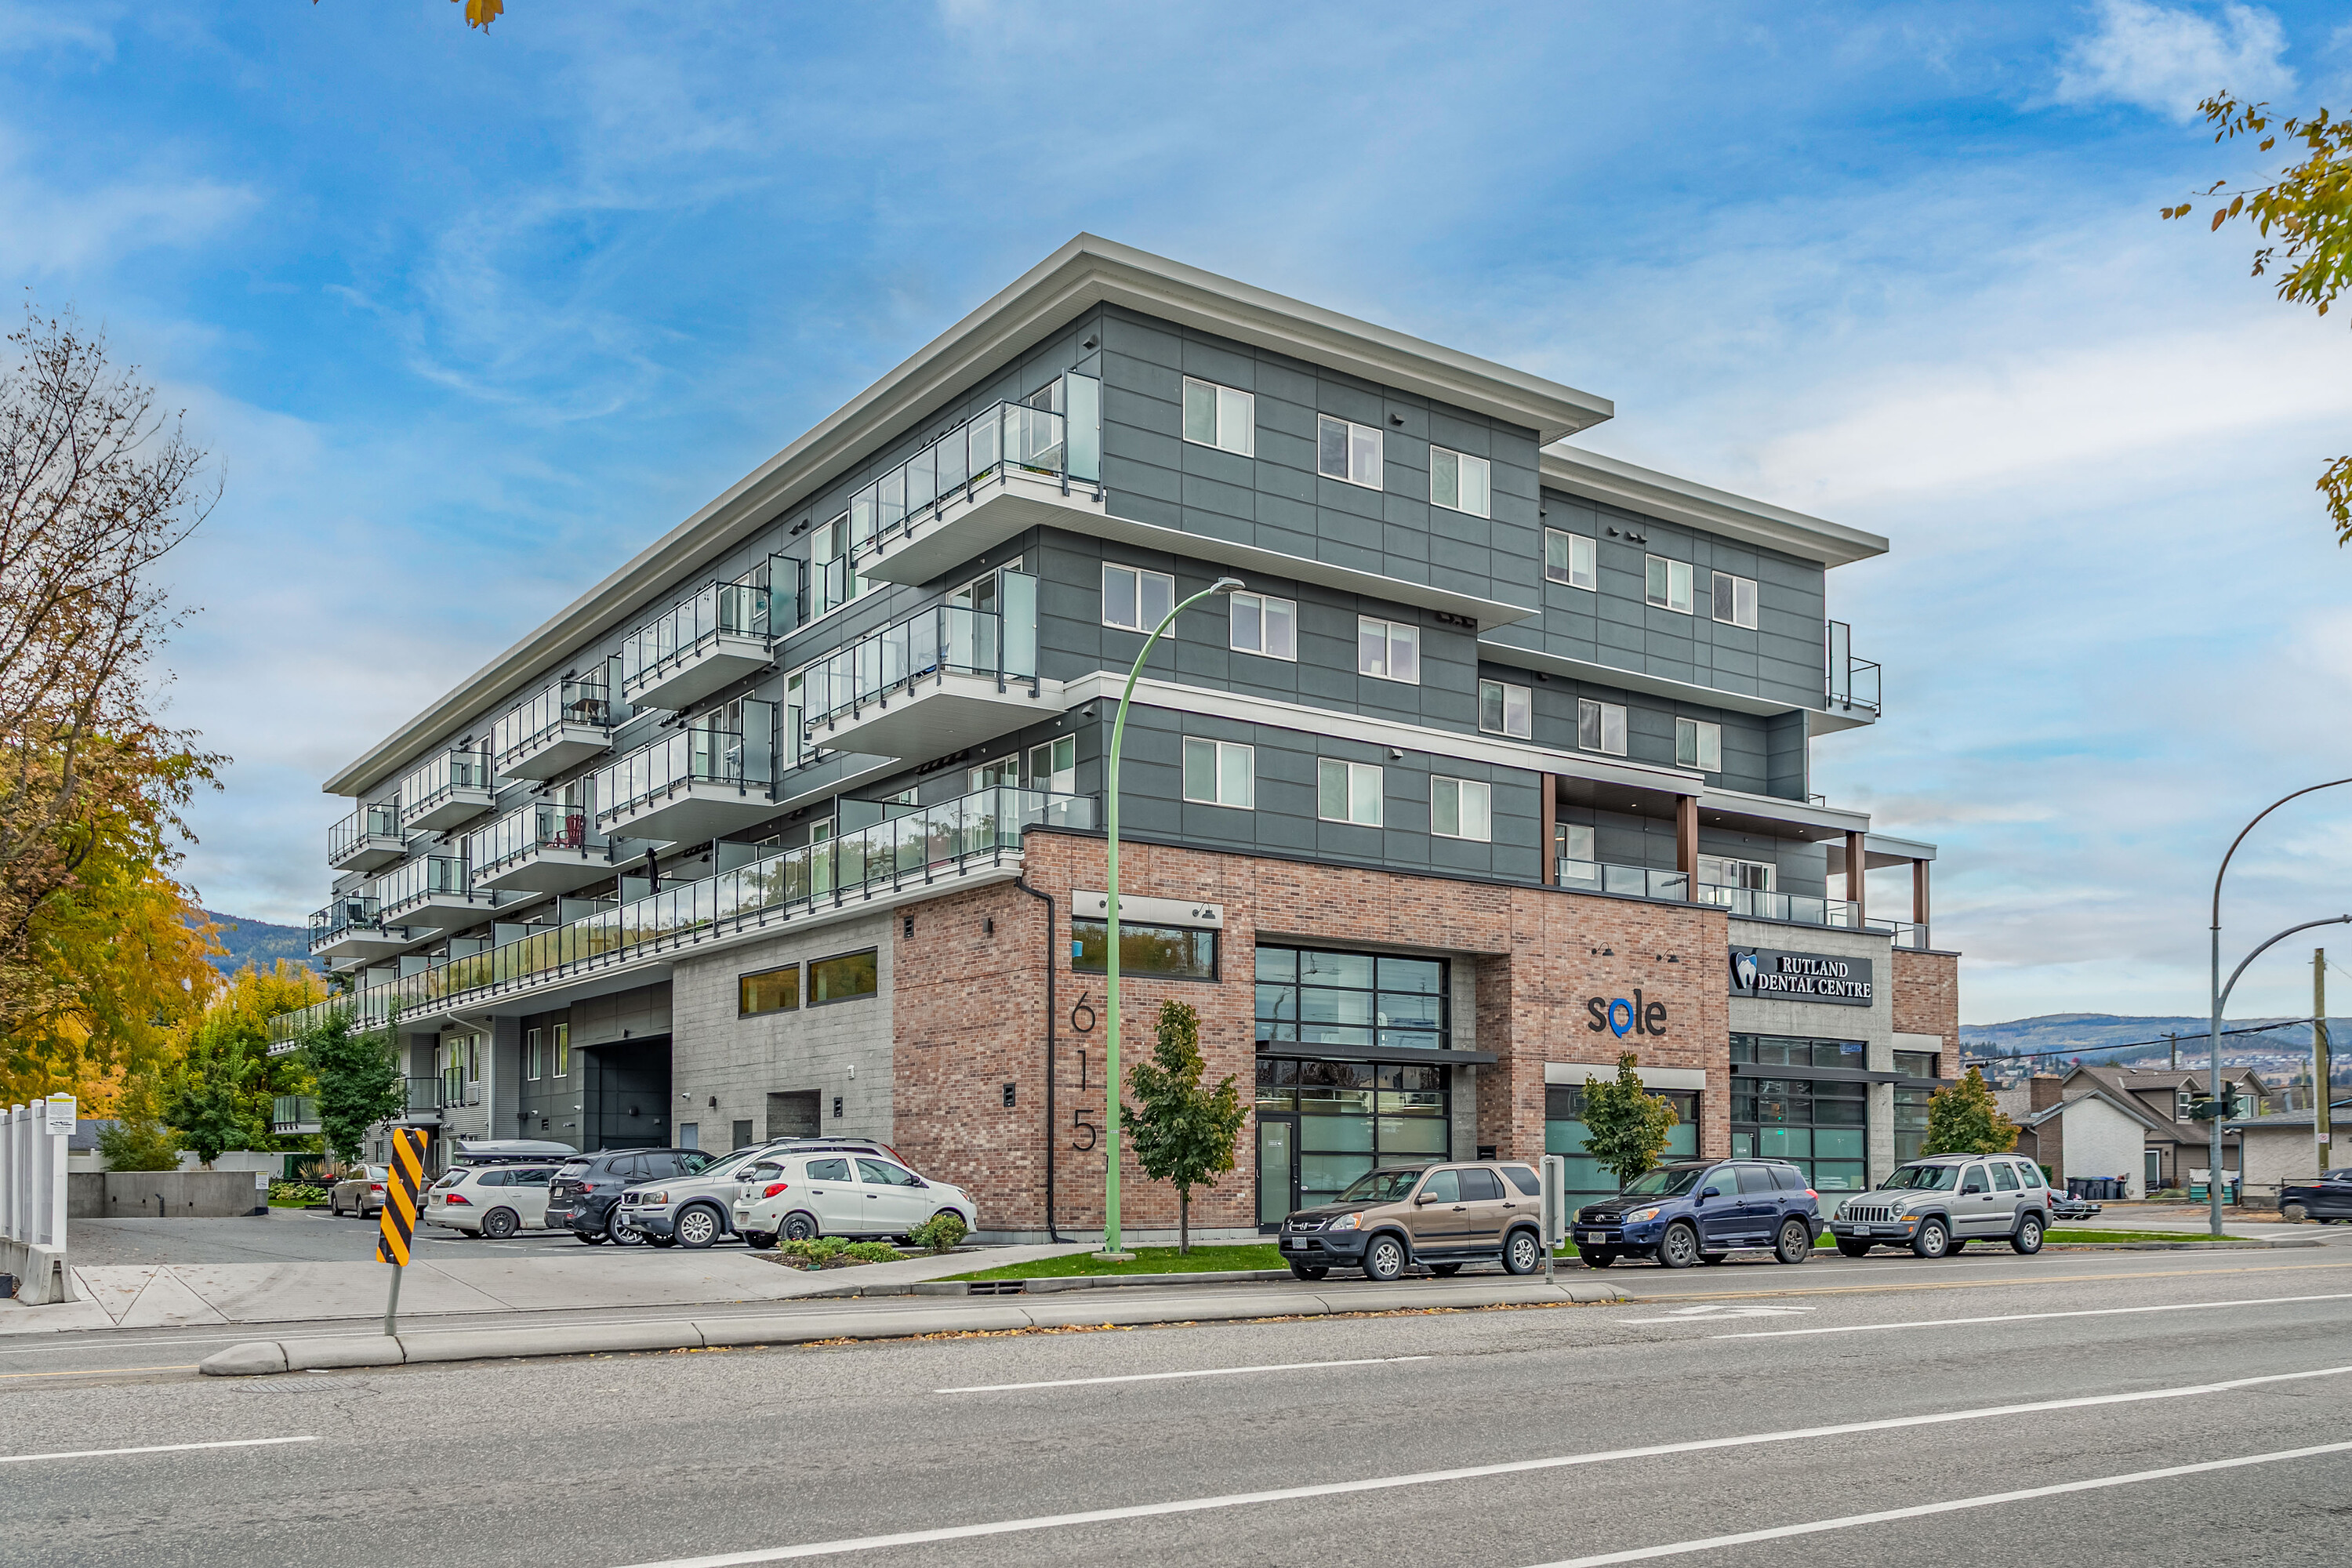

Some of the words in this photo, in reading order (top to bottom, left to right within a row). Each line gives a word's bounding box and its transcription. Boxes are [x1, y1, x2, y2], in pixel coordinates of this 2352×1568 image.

[1758, 973, 1815, 993] DENTAL
[1818, 978, 1871, 998] CENTRE
[1782, 956, 1849, 978] RUTLAND
[1588, 988, 1667, 1039] sole
[1072, 991, 1096, 1152] 615
